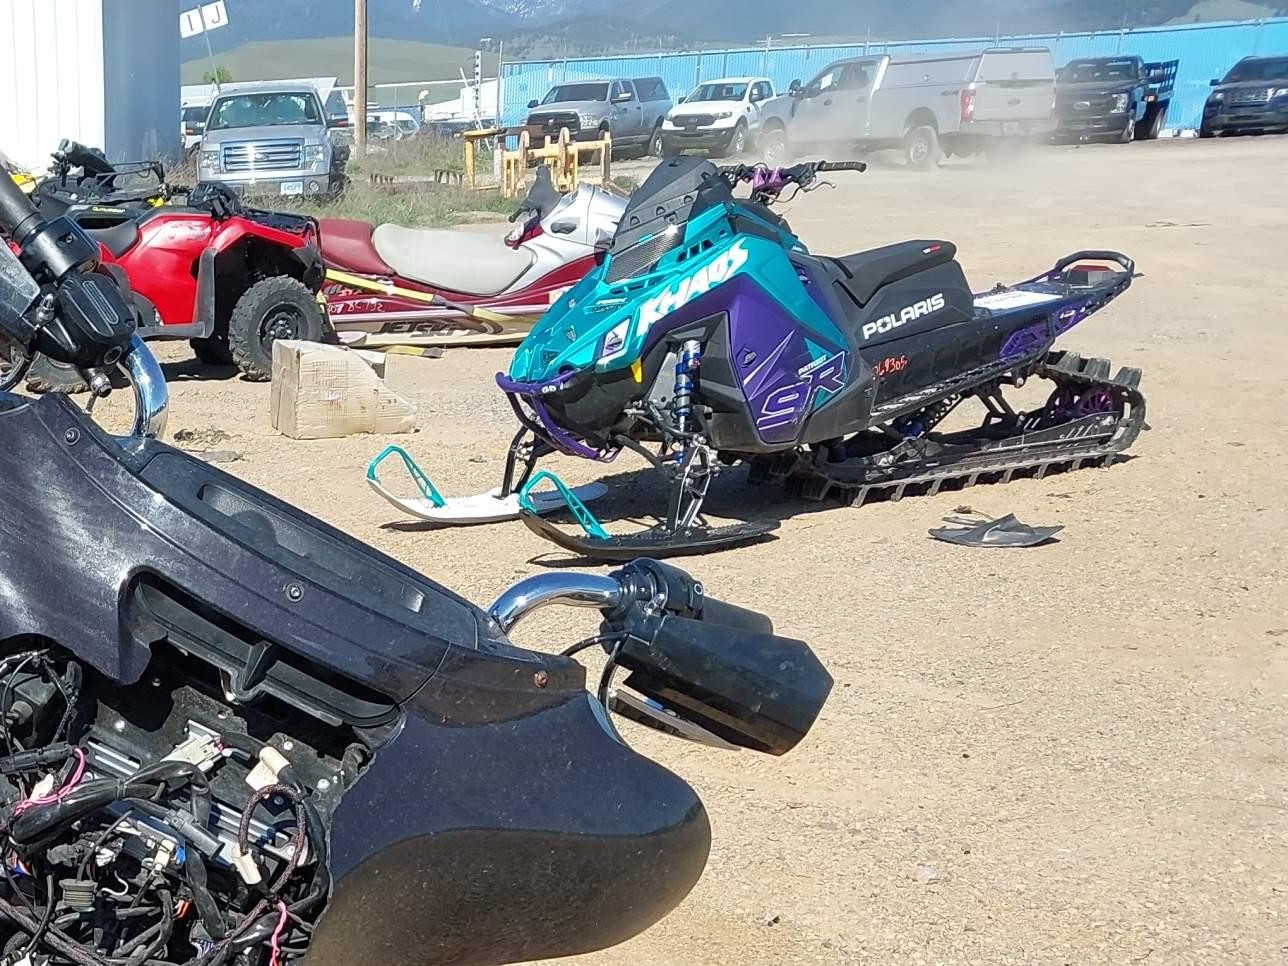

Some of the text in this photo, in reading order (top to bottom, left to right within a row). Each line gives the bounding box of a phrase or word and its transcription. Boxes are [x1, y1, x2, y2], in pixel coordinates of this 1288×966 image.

[211, 5, 221, 24] J
[636, 237, 749, 337] KHAOS
[862, 293, 946, 340] POLARIS
